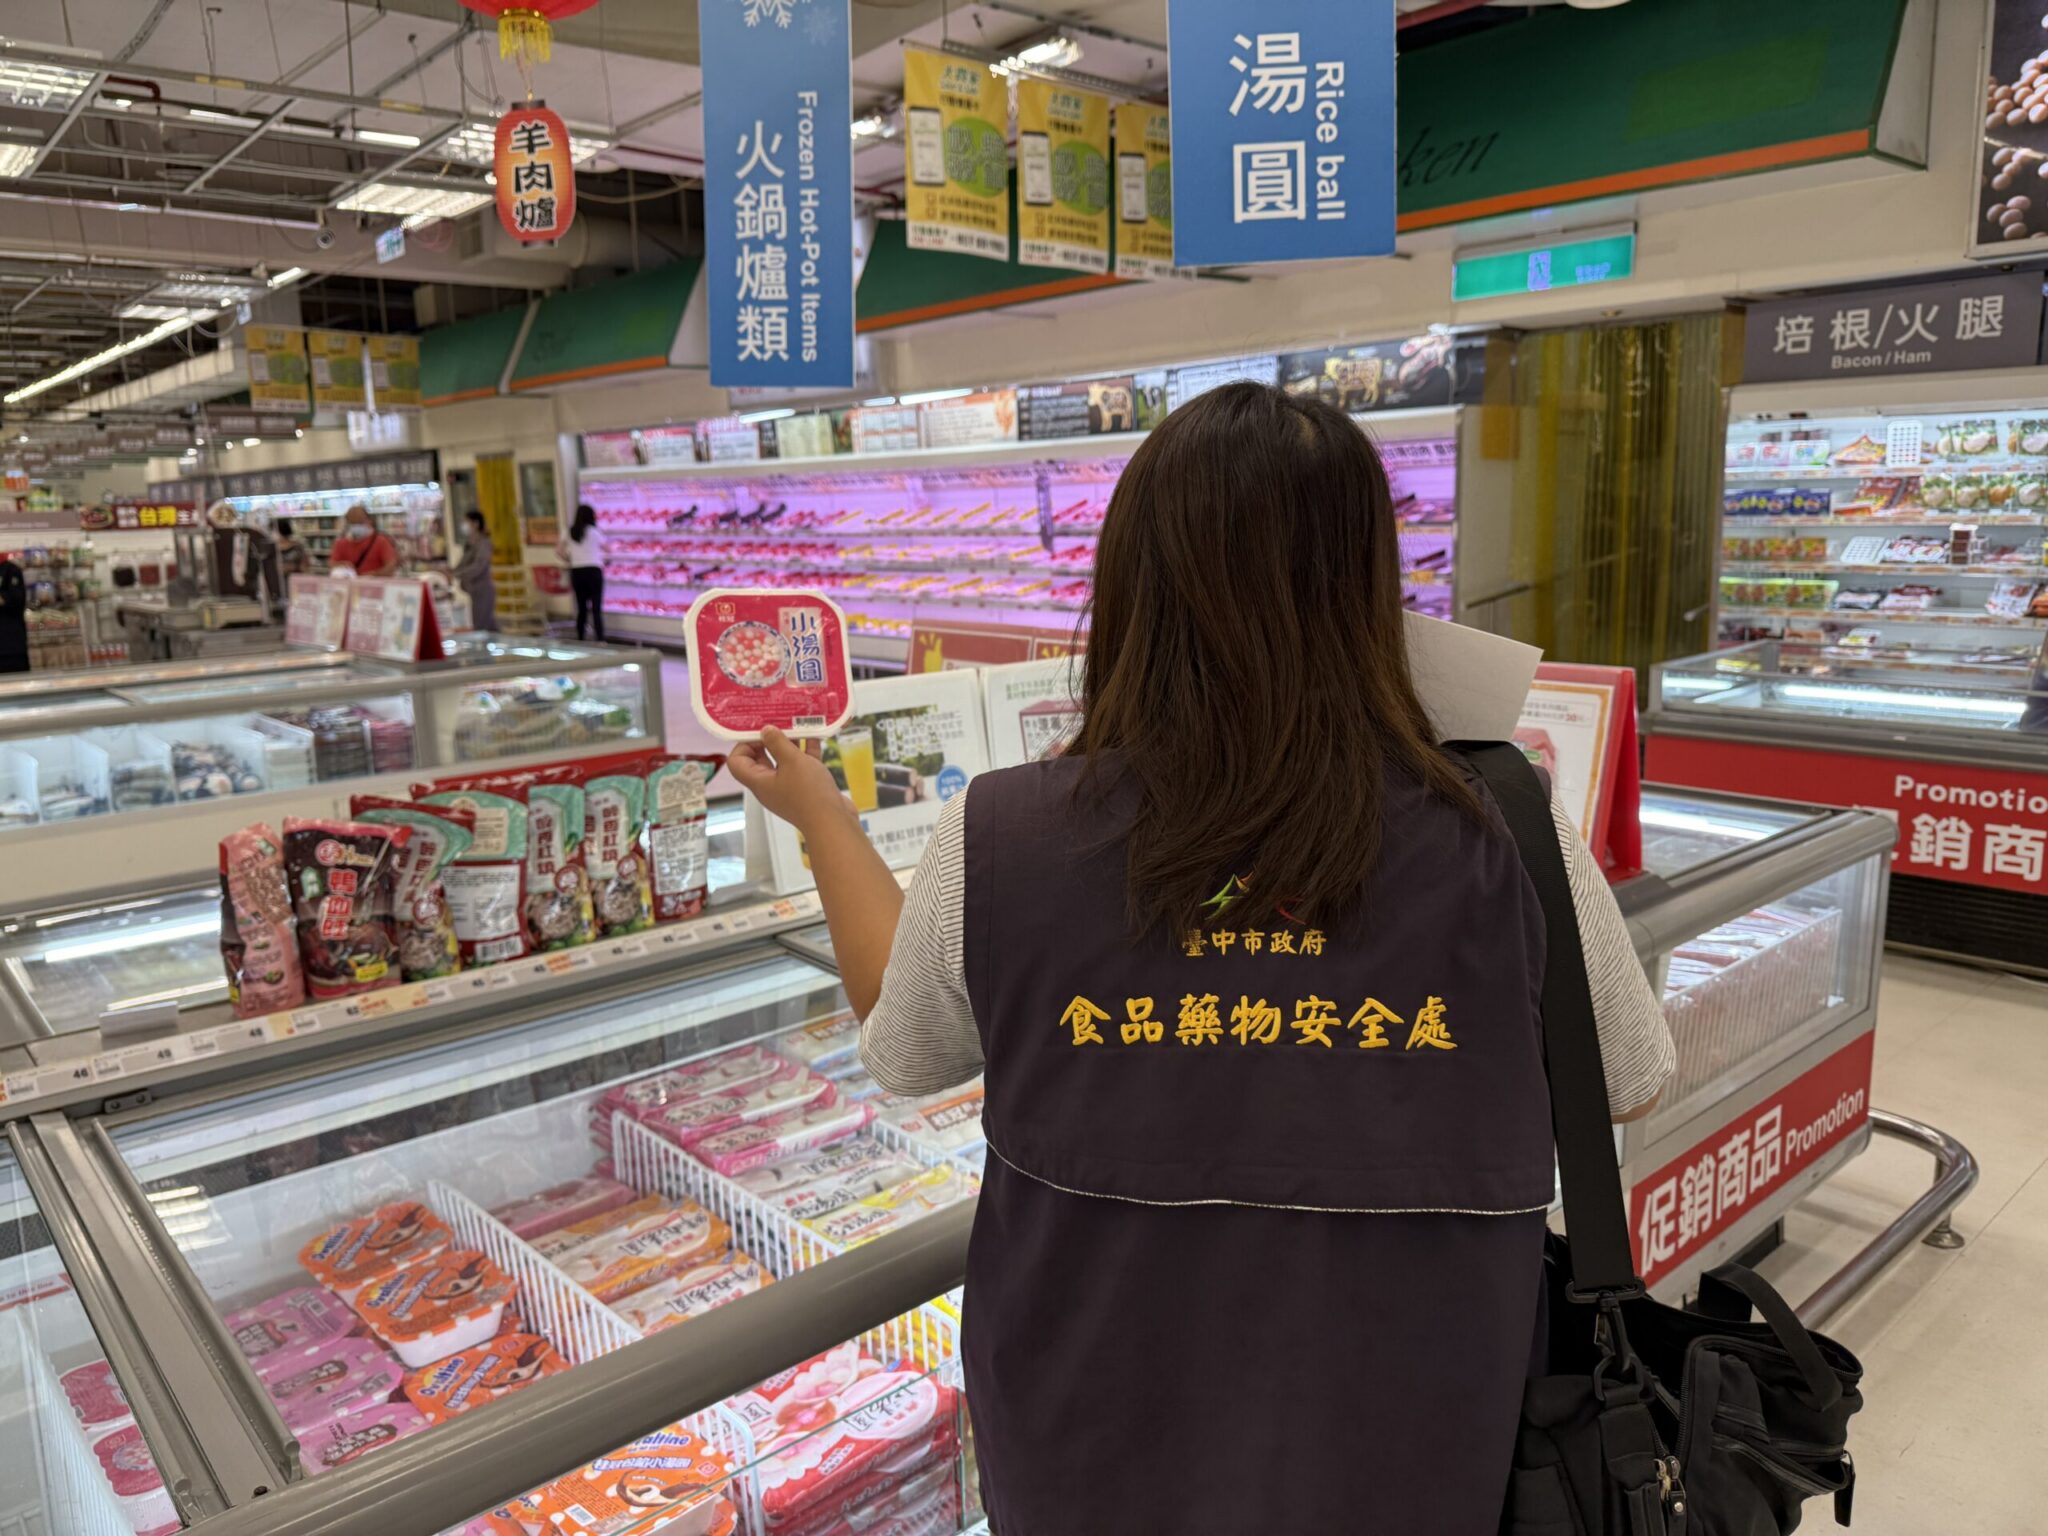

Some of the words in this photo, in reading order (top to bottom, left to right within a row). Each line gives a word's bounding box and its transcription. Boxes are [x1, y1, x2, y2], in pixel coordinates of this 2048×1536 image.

[797, 90, 818, 180] Frozen
[1228, 31, 1308, 224] 湯圓
[1315, 60, 1345, 144] Rice
[510, 121, 556, 231] 羊肉爐
[1316, 154, 1346, 221] ball
[733, 119, 790, 363] 火鍋爐類
[799, 188, 820, 286] Hot-Pot
[801, 293, 821, 363] Items
[1831, 352, 1882, 370] Bacon
[1893, 349, 1932, 365] Ham
[791, 611, 822, 682] 小湯圓
[1182, 928, 1328, 957] 臺中市政府
[1059, 993, 1459, 1051] 食品藥物安全處
[1785, 1088, 1864, 1166] Promotion
[1639, 1103, 1783, 1278] 促銷商品
[419, 1356, 466, 1398] Ovaltine
[633, 1432, 692, 1450] altine
